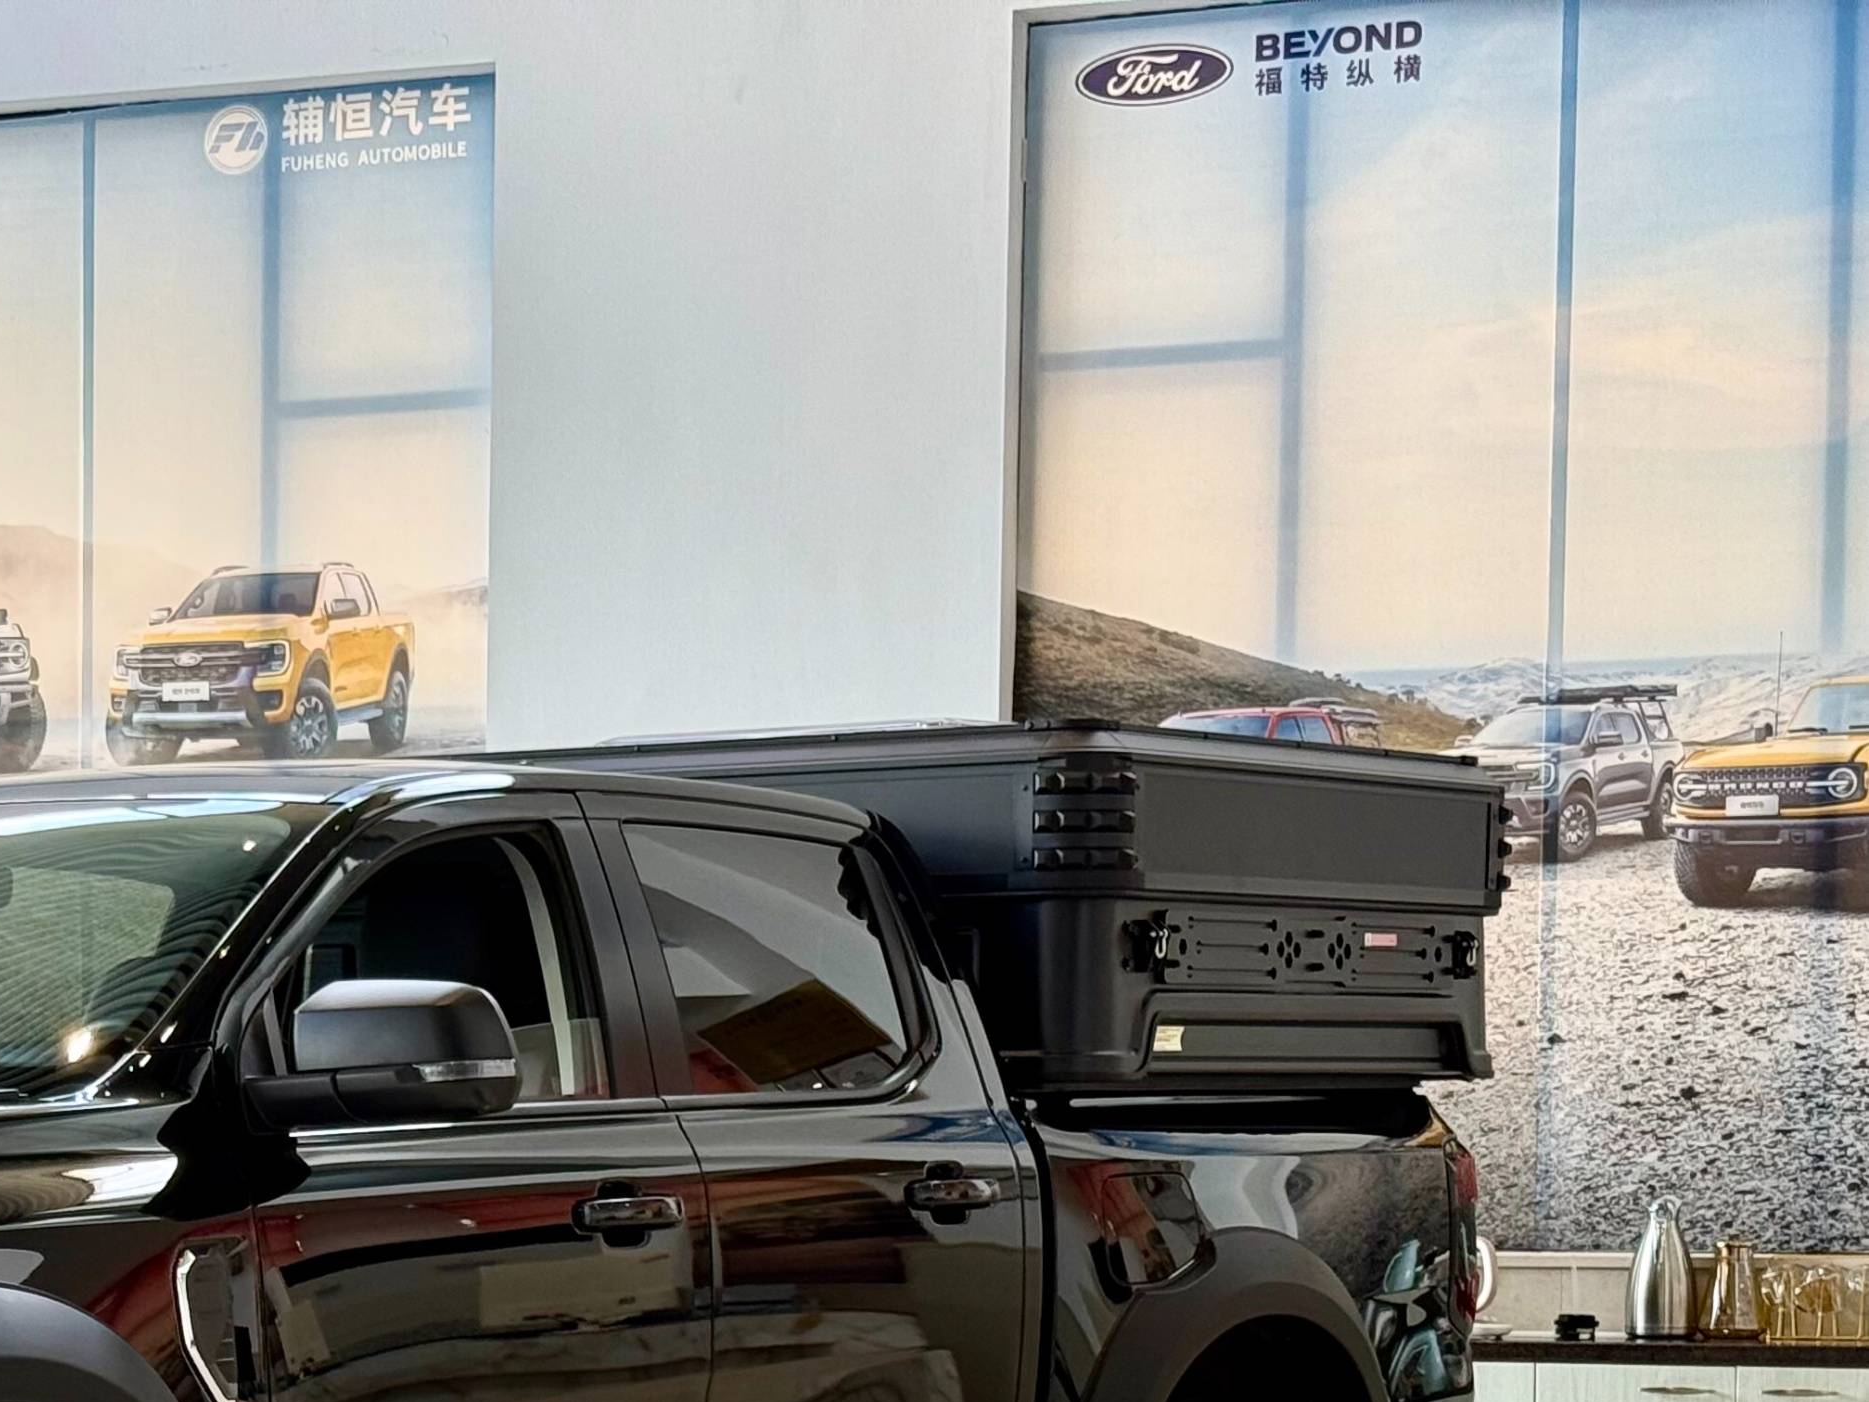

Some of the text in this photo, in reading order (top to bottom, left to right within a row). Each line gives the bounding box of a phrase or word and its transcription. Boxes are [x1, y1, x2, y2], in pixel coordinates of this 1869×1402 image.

[1254, 20, 1423, 62] BEYOND
[1104, 51, 1206, 99] Ford
[1254, 54, 1422, 96] 福特纵横
[282, 83, 472, 146] 辅恒汽车
[281, 141, 467, 173] FUHENG AUTOMOBILE
